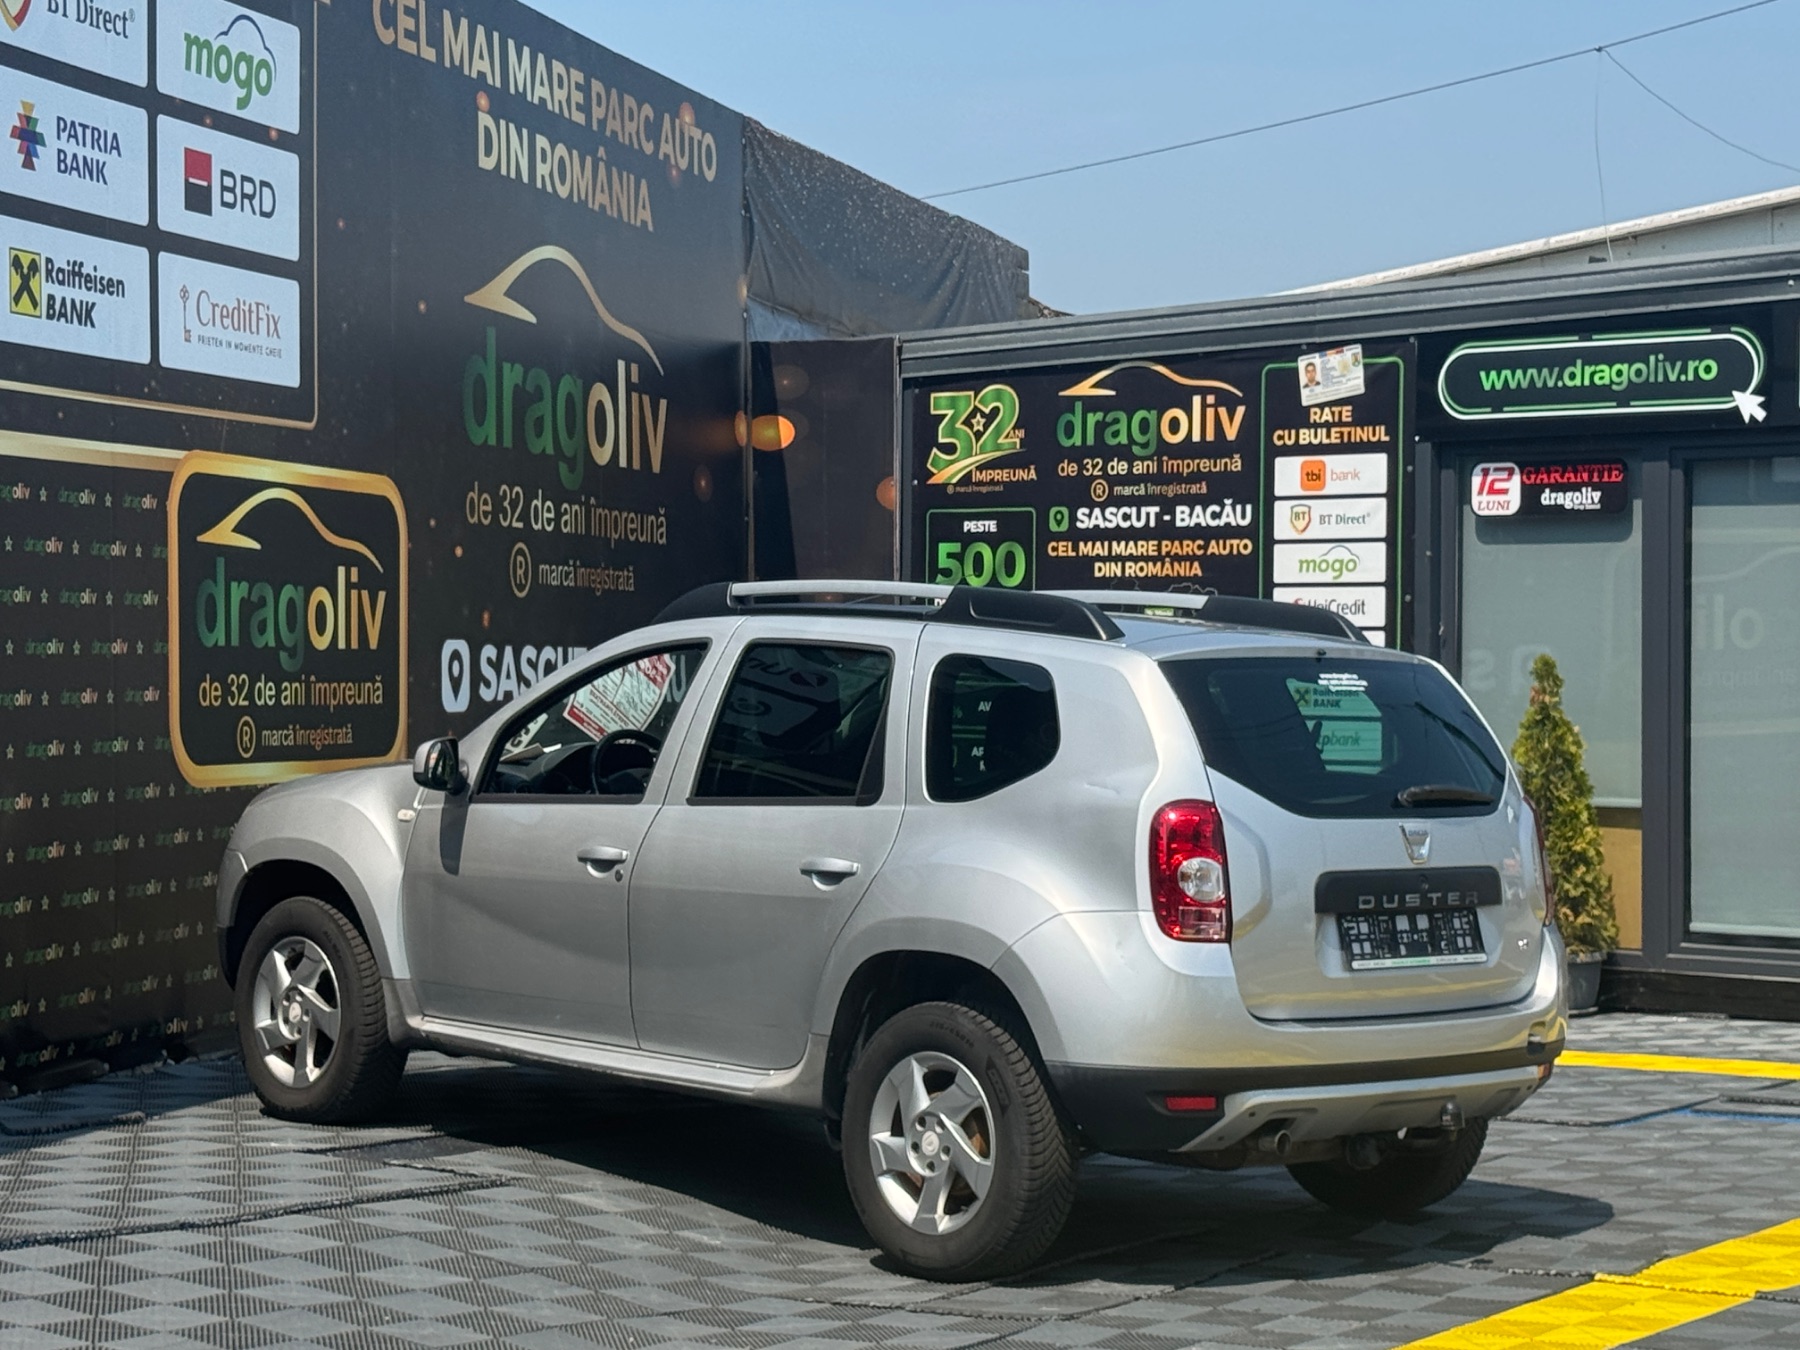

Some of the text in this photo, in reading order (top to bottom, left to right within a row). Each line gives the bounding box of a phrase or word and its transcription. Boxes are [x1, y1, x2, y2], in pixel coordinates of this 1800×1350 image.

[183, 32, 272, 110] mogo
[372, 0, 717, 182] CEL MAI MARE PARC AUTO
[56, 115, 122, 158] PATRIA
[57, 147, 108, 186] BANK
[477, 111, 654, 232] DIN ROMÂNIA
[219, 169, 276, 219] BRD
[45, 257, 126, 299] Raiffeisen
[45, 293, 97, 329] BANK
[196, 290, 281, 339] CreditFix
[1479, 353, 1719, 391] www.dragoliv.ro
[463, 326, 668, 491] dragoliv
[1309, 405, 1353, 424] RATE
[927, 384, 1019, 474] 32
[1008, 428, 1025, 438] ANI
[1056, 394, 1246, 457] dragoliv
[1273, 425, 1390, 446] CU BULETINUL
[972, 465, 1037, 483] ÎMPREUNĂ
[1058, 454, 1242, 477] de 32 de ani împreună
[1305, 468, 1360, 482] tbi bank
[1477, 466, 1515, 496] 12
[1522, 464, 1624, 484] GARANTIE
[1113, 483, 1145, 496] marcă
[1147, 481, 1208, 497] înregistrată
[1541, 487, 1601, 509] dragoliv
[466, 481, 667, 549] de 32 de ani împreună
[1075, 506, 1160, 529] SASCUT
[1175, 498, 1252, 528] BACĂU
[1319, 513, 1333, 525] BT
[1477, 500, 1510, 512] LUNI
[963, 520, 998, 533] PESTE
[1047, 538, 1253, 557] CEL MAI MARE PARC AUTO
[538, 560, 575, 587] marcă
[576, 560, 635, 596] înregistrată
[935, 541, 1026, 588] 500
[1094, 558, 1203, 578] DIN ROMÂNIA
[1298, 558, 1357, 580] mogo
[196, 556, 387, 672] dragoliv
[479, 644, 587, 702] SASC
[199, 673, 383, 713] de 32 de ani împreună
[261, 724, 294, 746] marcă
[295, 723, 353, 750] înregistrată
[1358, 892, 1478, 909] DUSTER
